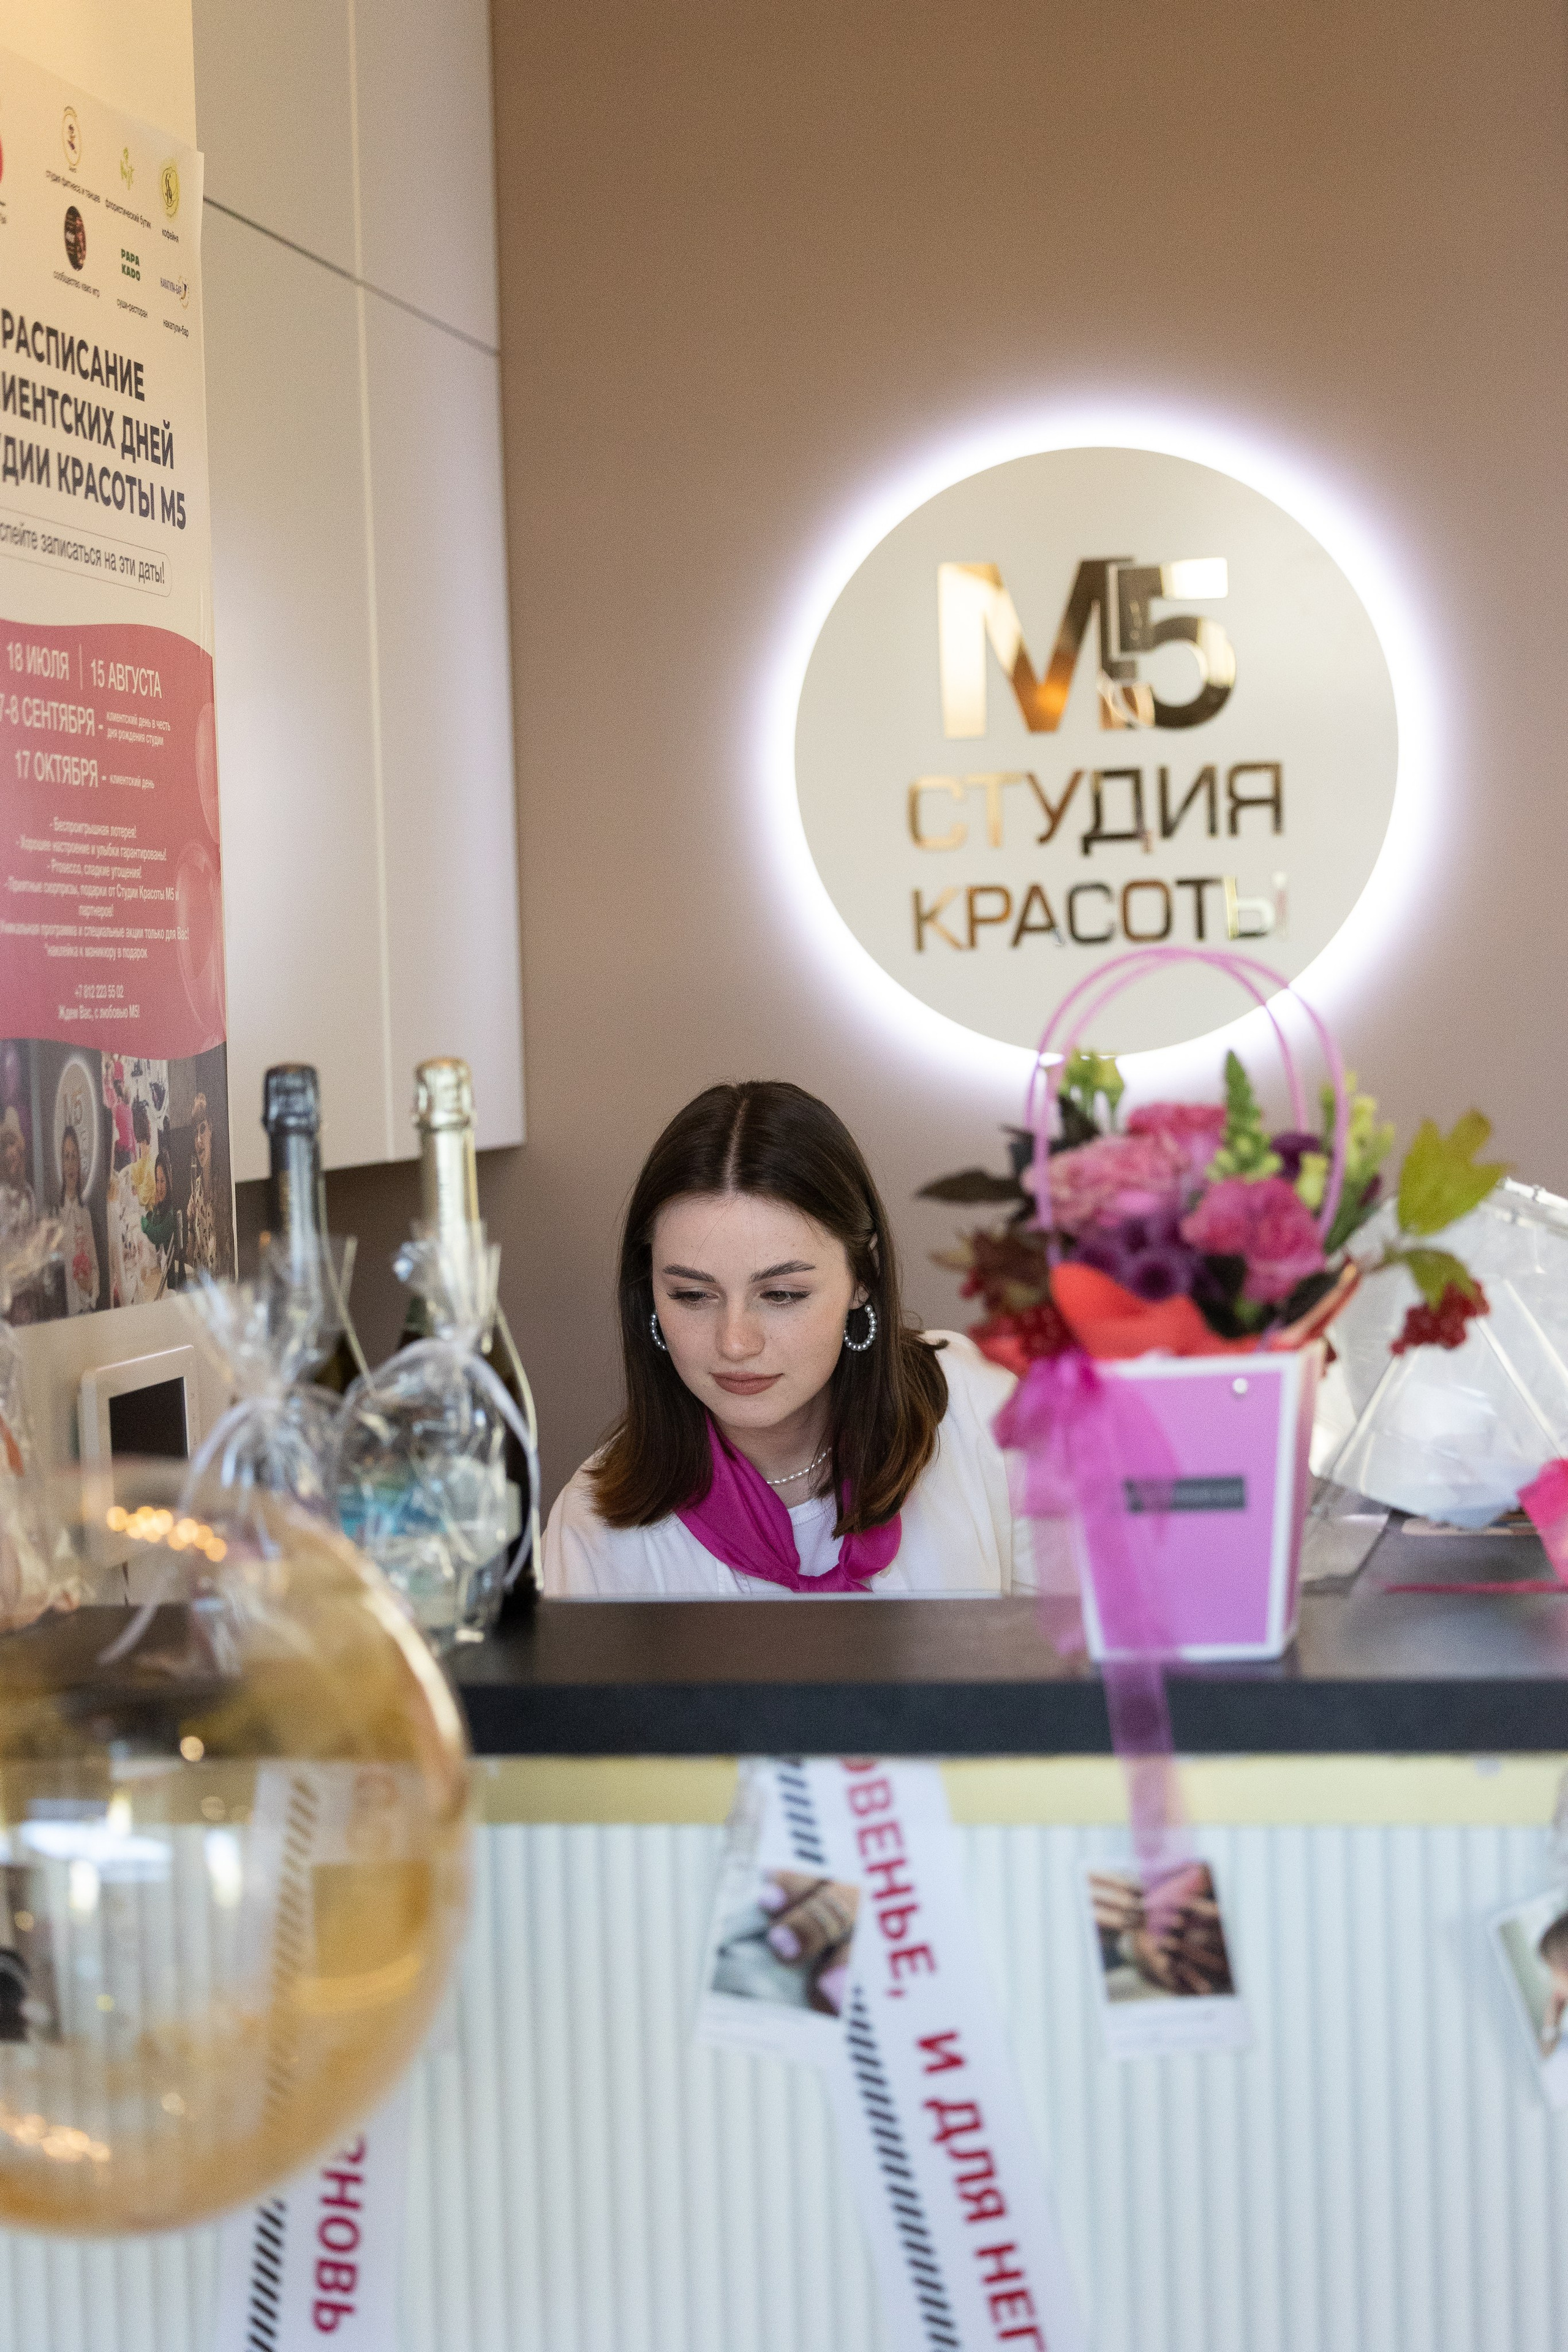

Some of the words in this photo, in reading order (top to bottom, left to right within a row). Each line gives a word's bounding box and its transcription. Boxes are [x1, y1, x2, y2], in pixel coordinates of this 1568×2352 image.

[162, 228, 179, 243] кофейня
[121, 248, 140, 266] PAPA
[121, 263, 141, 281] KADO
[2, 308, 145, 402] РАСПИСАНИЕ
[2, 371, 116, 450] ИЕНТСКИХ
[121, 420, 175, 470] ДНЕЙ
[58, 452, 156, 521] КРАСОТЫ
[161, 486, 187, 530] М5
[41, 534, 102, 567] записаться
[104, 551, 116, 571] на
[119, 556, 135, 576] эти
[138, 561, 165, 584] даты!
[6, 641, 23, 673] 18
[26, 645, 70, 681] ИЮЛЯ
[937, 556, 1237, 740] М5
[91, 659, 105, 688] 15
[108, 662, 162, 699] АВГУСТА
[22, 696, 96, 737] СЕНТЯБРЯ
[138, 717, 152, 728] день
[156, 720, 172, 731] честь
[146, 734, 164, 747] студии
[15, 749, 31, 780] 17
[33, 751, 99, 788] ОКТЯБРЯ
[141, 778, 155, 790] день
[906, 760, 1284, 857] СТУДИЯ
[120, 847, 167, 862] гарантированы!
[108, 886, 116, 897] от
[116, 883, 138, 901] Студии
[139, 885, 165, 902] Красоты
[165, 887, 175, 901] М5
[911, 871, 1287, 954] КРАСОТЫ
[126, 927, 144, 940] акции
[144, 928, 165, 939] только
[165, 929, 176, 941] для
[176, 925, 189, 940] Вас!
[123, 948, 148, 961] подарок
[916, 2032, 966, 2075] И
[922, 2098, 1008, 2225] ДЛЯ
